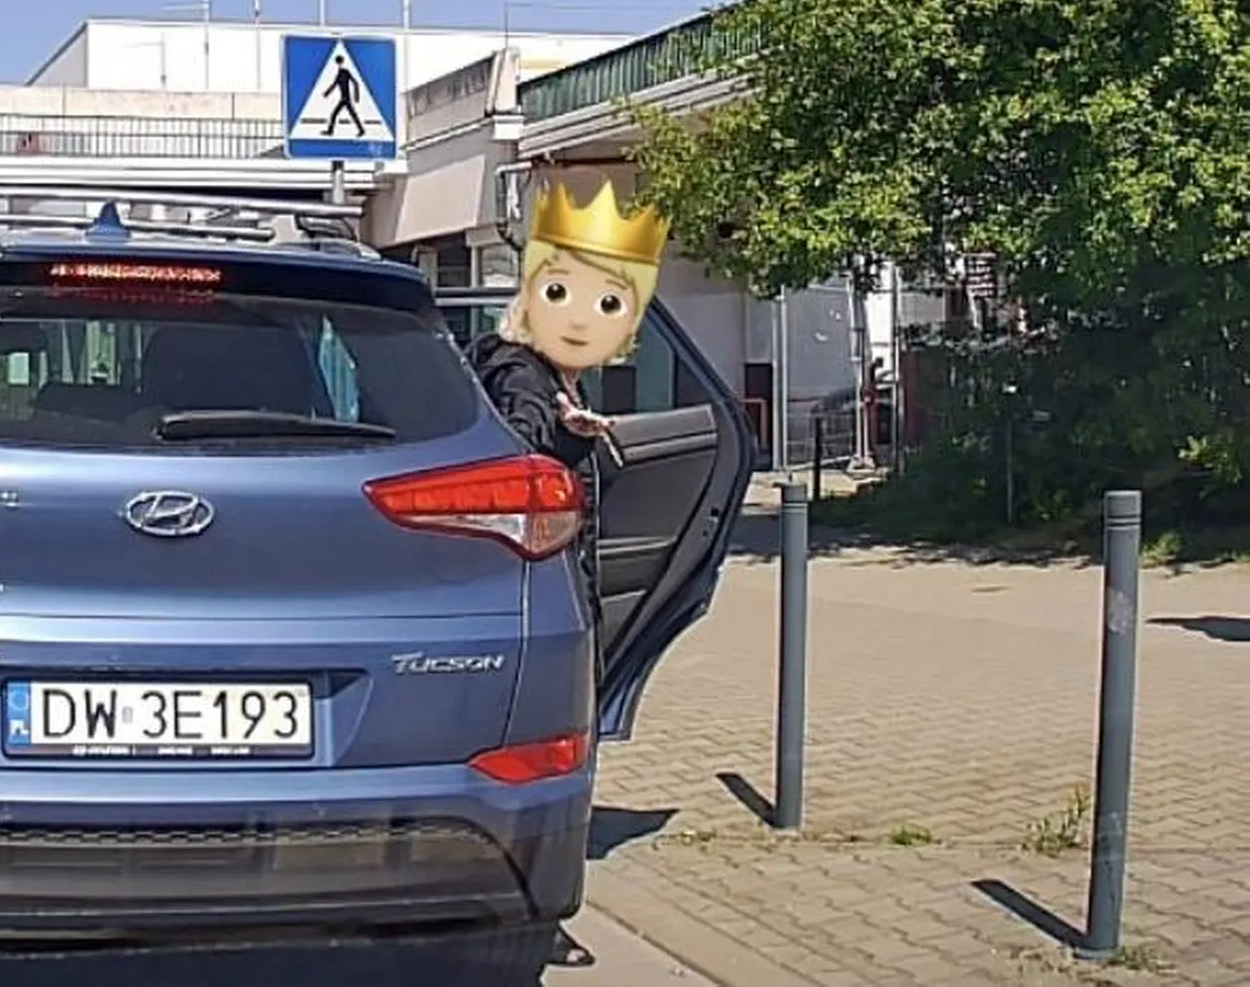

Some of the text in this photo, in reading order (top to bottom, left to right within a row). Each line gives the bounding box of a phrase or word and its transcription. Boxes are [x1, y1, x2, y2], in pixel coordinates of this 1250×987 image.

[391, 652, 505, 674] TUCSON
[43, 688, 298, 739] DW 3E193
